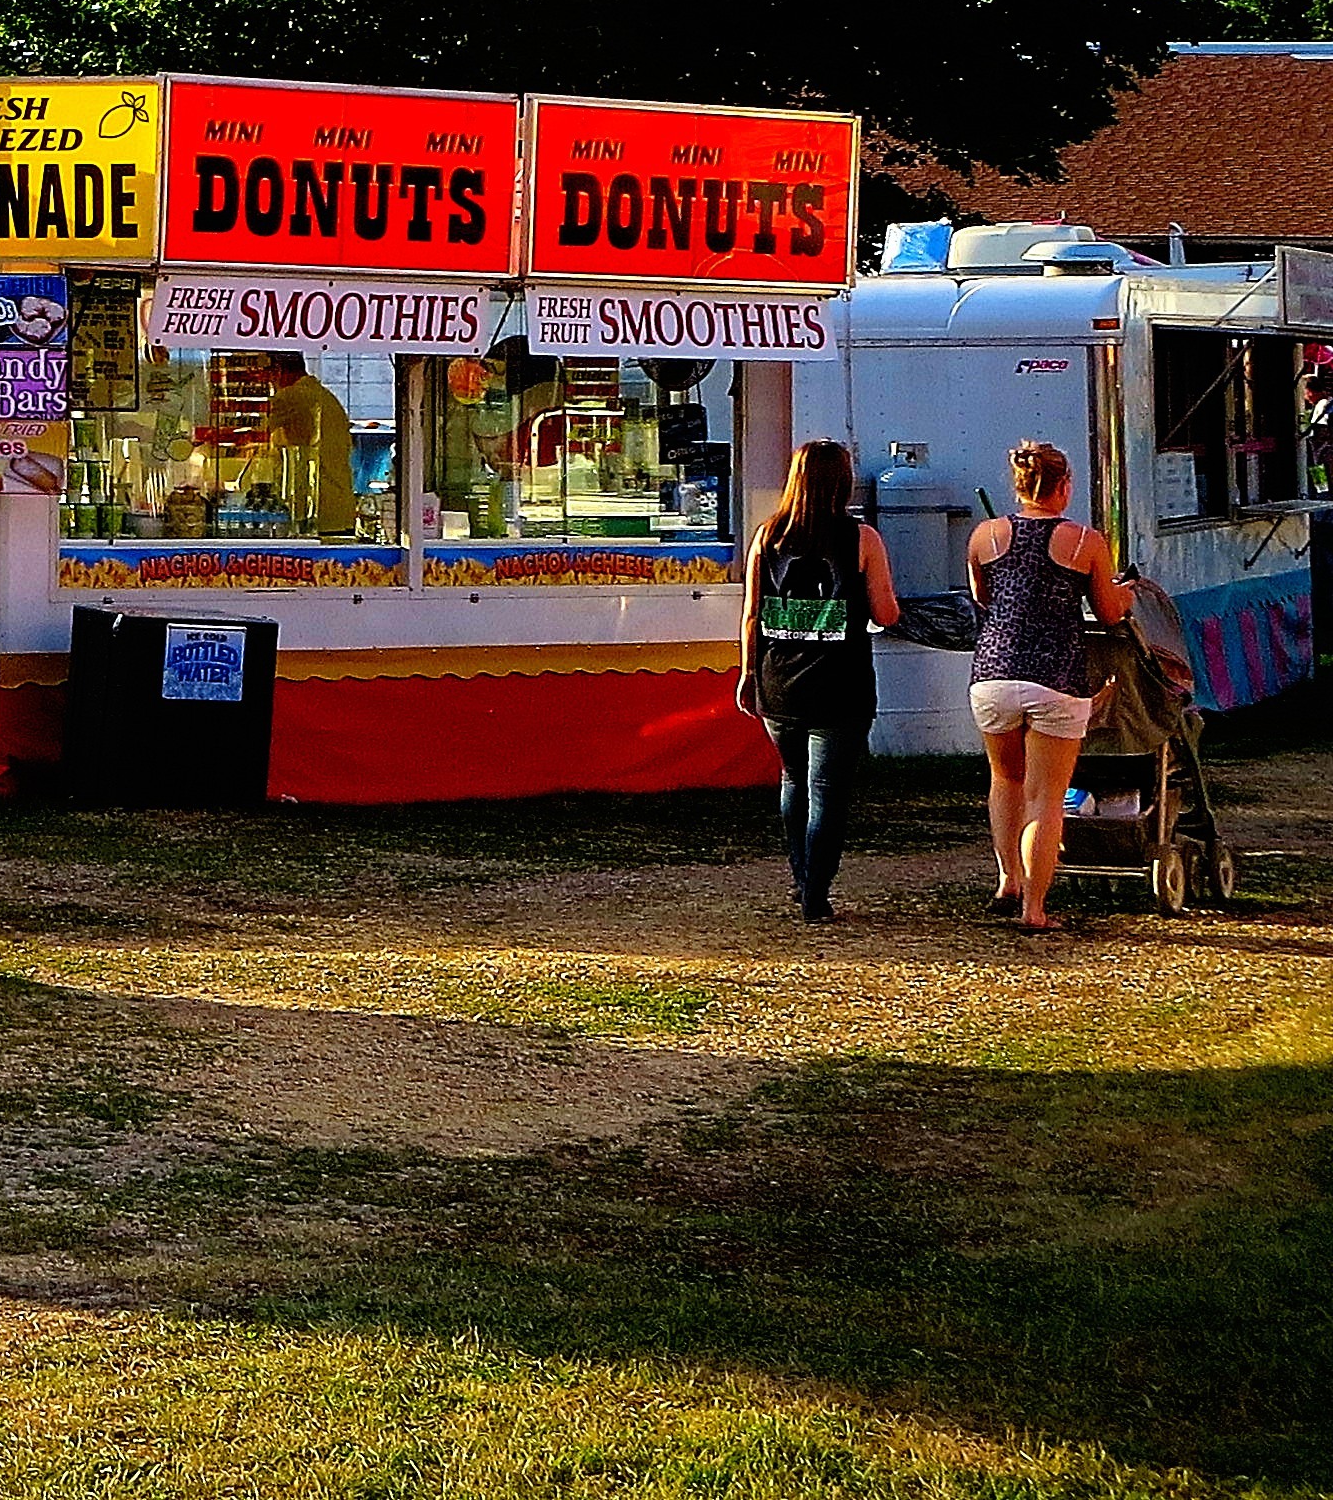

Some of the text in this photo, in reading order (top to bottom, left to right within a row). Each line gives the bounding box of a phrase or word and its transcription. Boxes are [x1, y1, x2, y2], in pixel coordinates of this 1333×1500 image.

[204, 120, 482, 155] MINI MINI MINI
[571, 140, 828, 173] MINI MINI MINI
[192, 156, 486, 245] DONUTS
[558, 172, 826, 258] DONUTS
[163, 312, 228, 337] FRUIT
[166, 287, 479, 343] FRESH SMOOTHIES
[537, 296, 826, 350] FRESH SMOOTHIES
[538, 320, 591, 344] FRUIT
[3, 424, 47, 437] FRIED
[140, 552, 221, 581] NACHOS
[244, 554, 314, 582] CHEESE
[495, 551, 571, 579] NACHOS
[590, 553, 655, 581] CHEESE
[171, 642, 239, 666] BOTTLED
[176, 662, 232, 685] WATER
